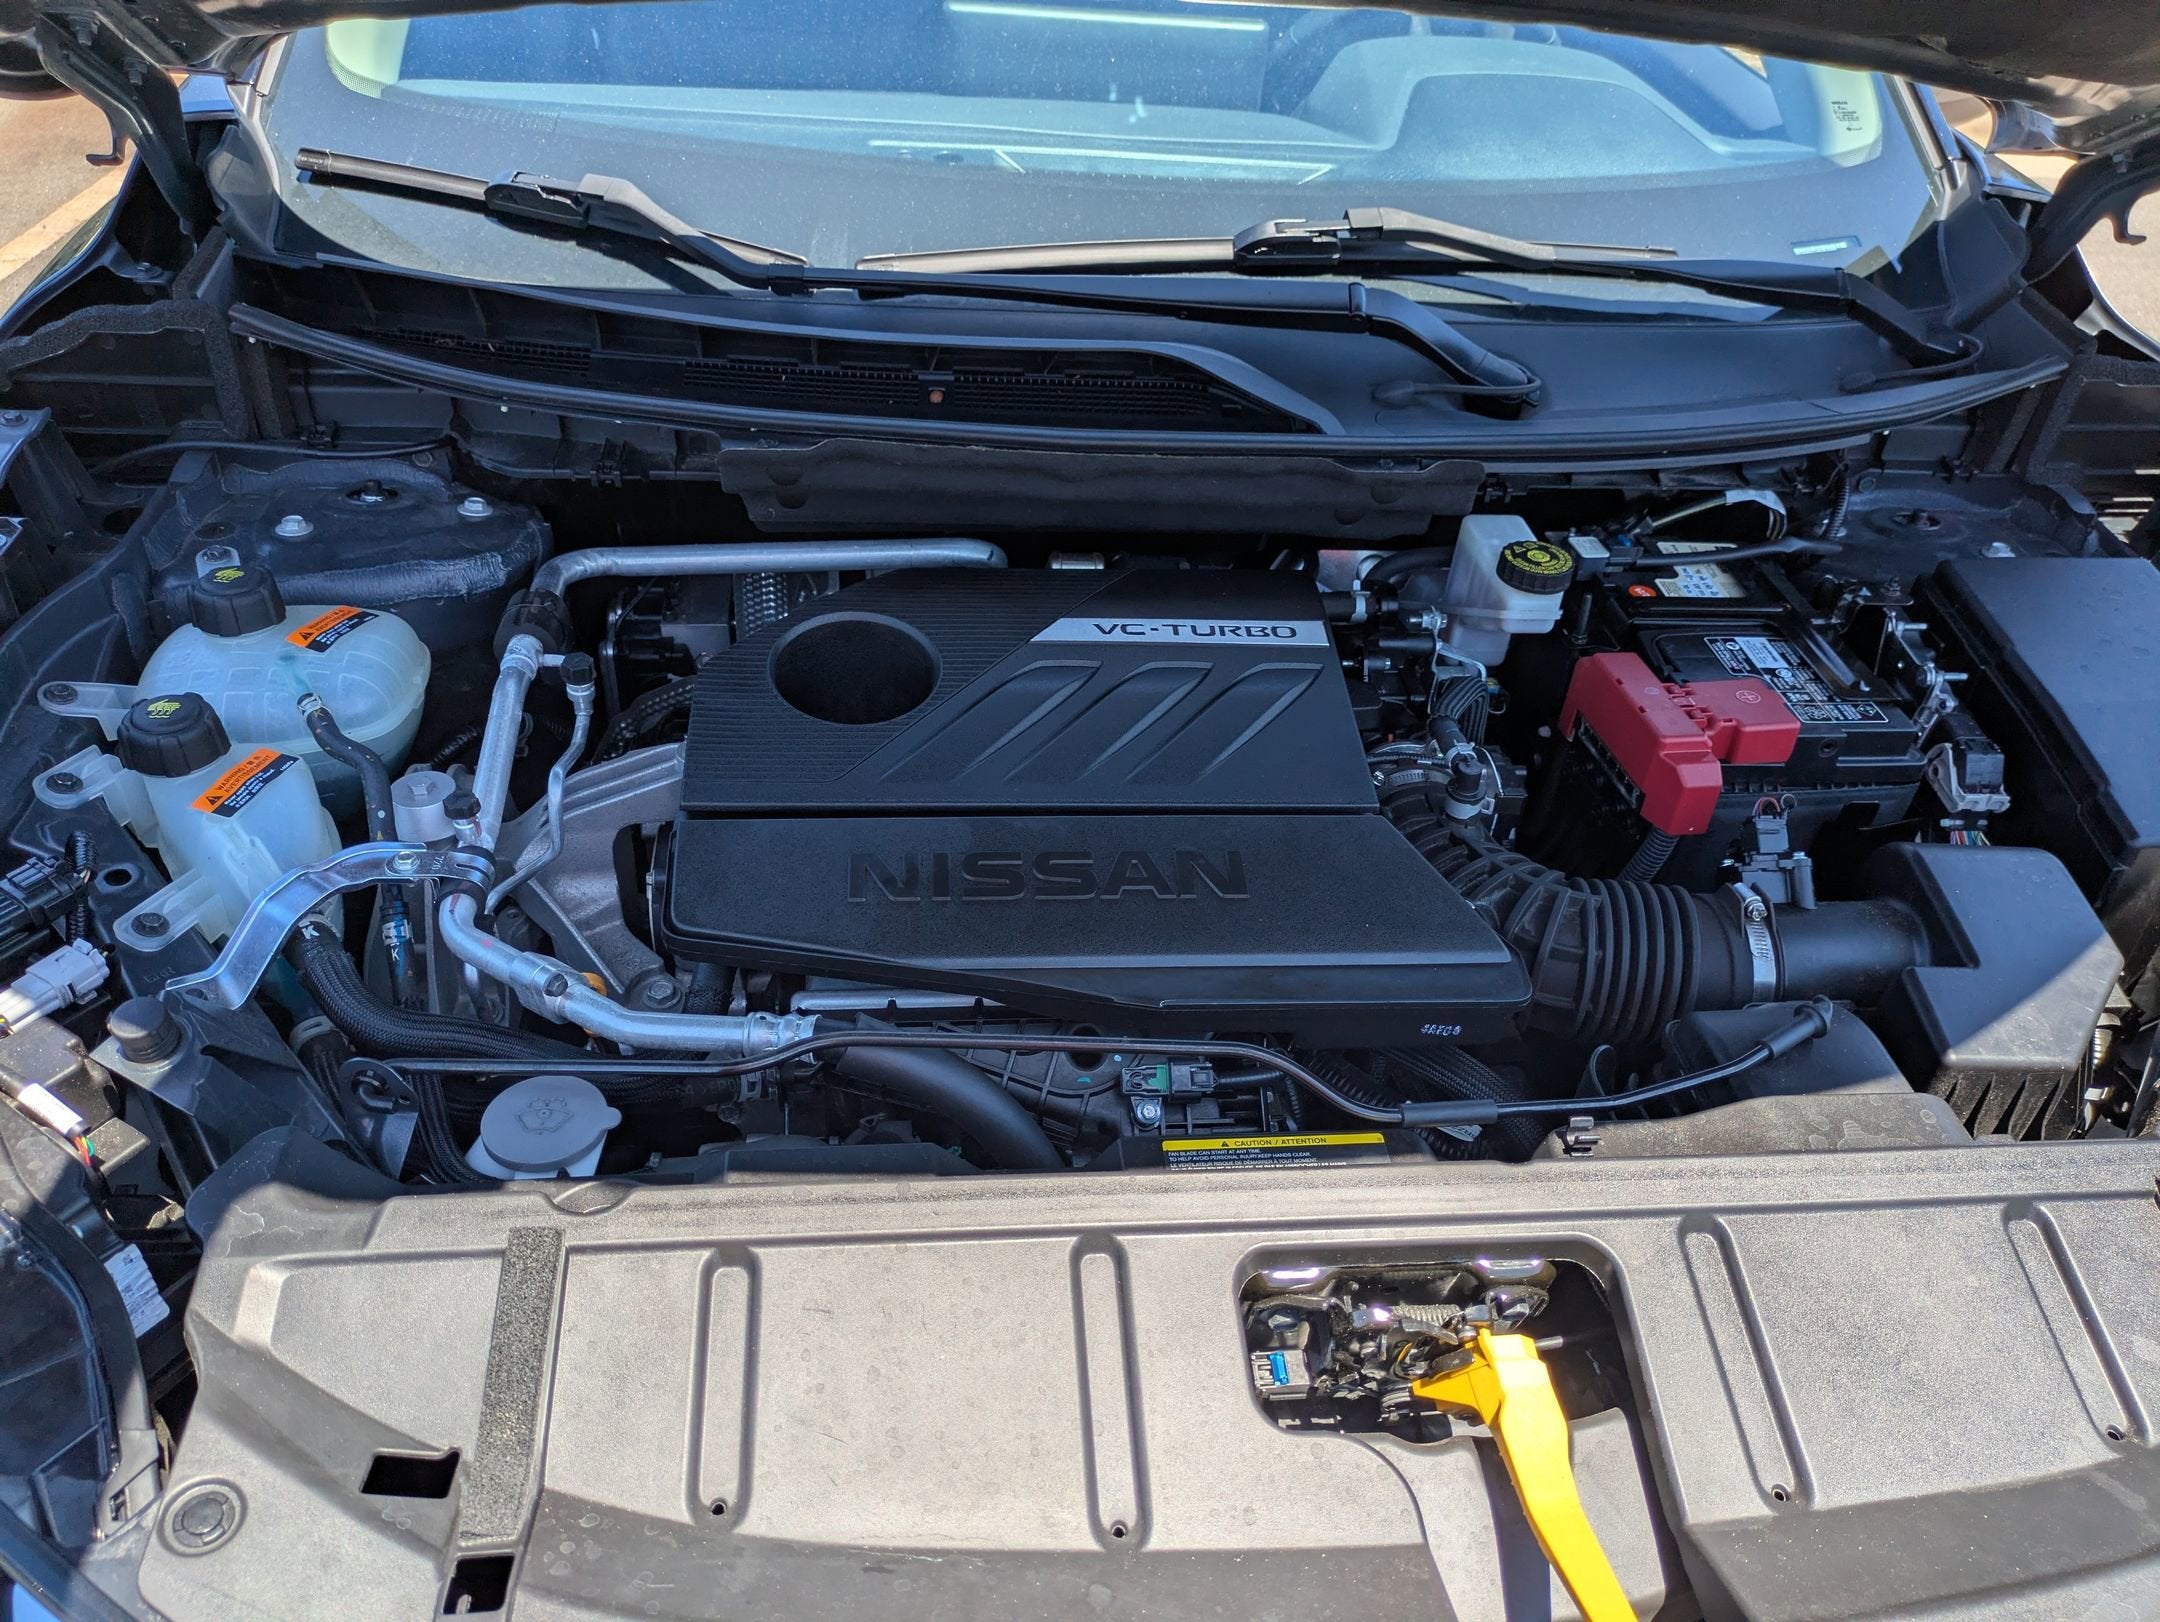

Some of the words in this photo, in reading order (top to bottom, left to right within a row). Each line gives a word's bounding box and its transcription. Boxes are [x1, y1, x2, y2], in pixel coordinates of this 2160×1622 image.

[1092, 623, 1297, 638] VC-TURBO
[216, 767, 246, 791] WARNING
[847, 851, 1250, 902] NISSAN
[391, 948, 400, 962] K
[1281, 1137, 1327, 1145] ATTENTION
